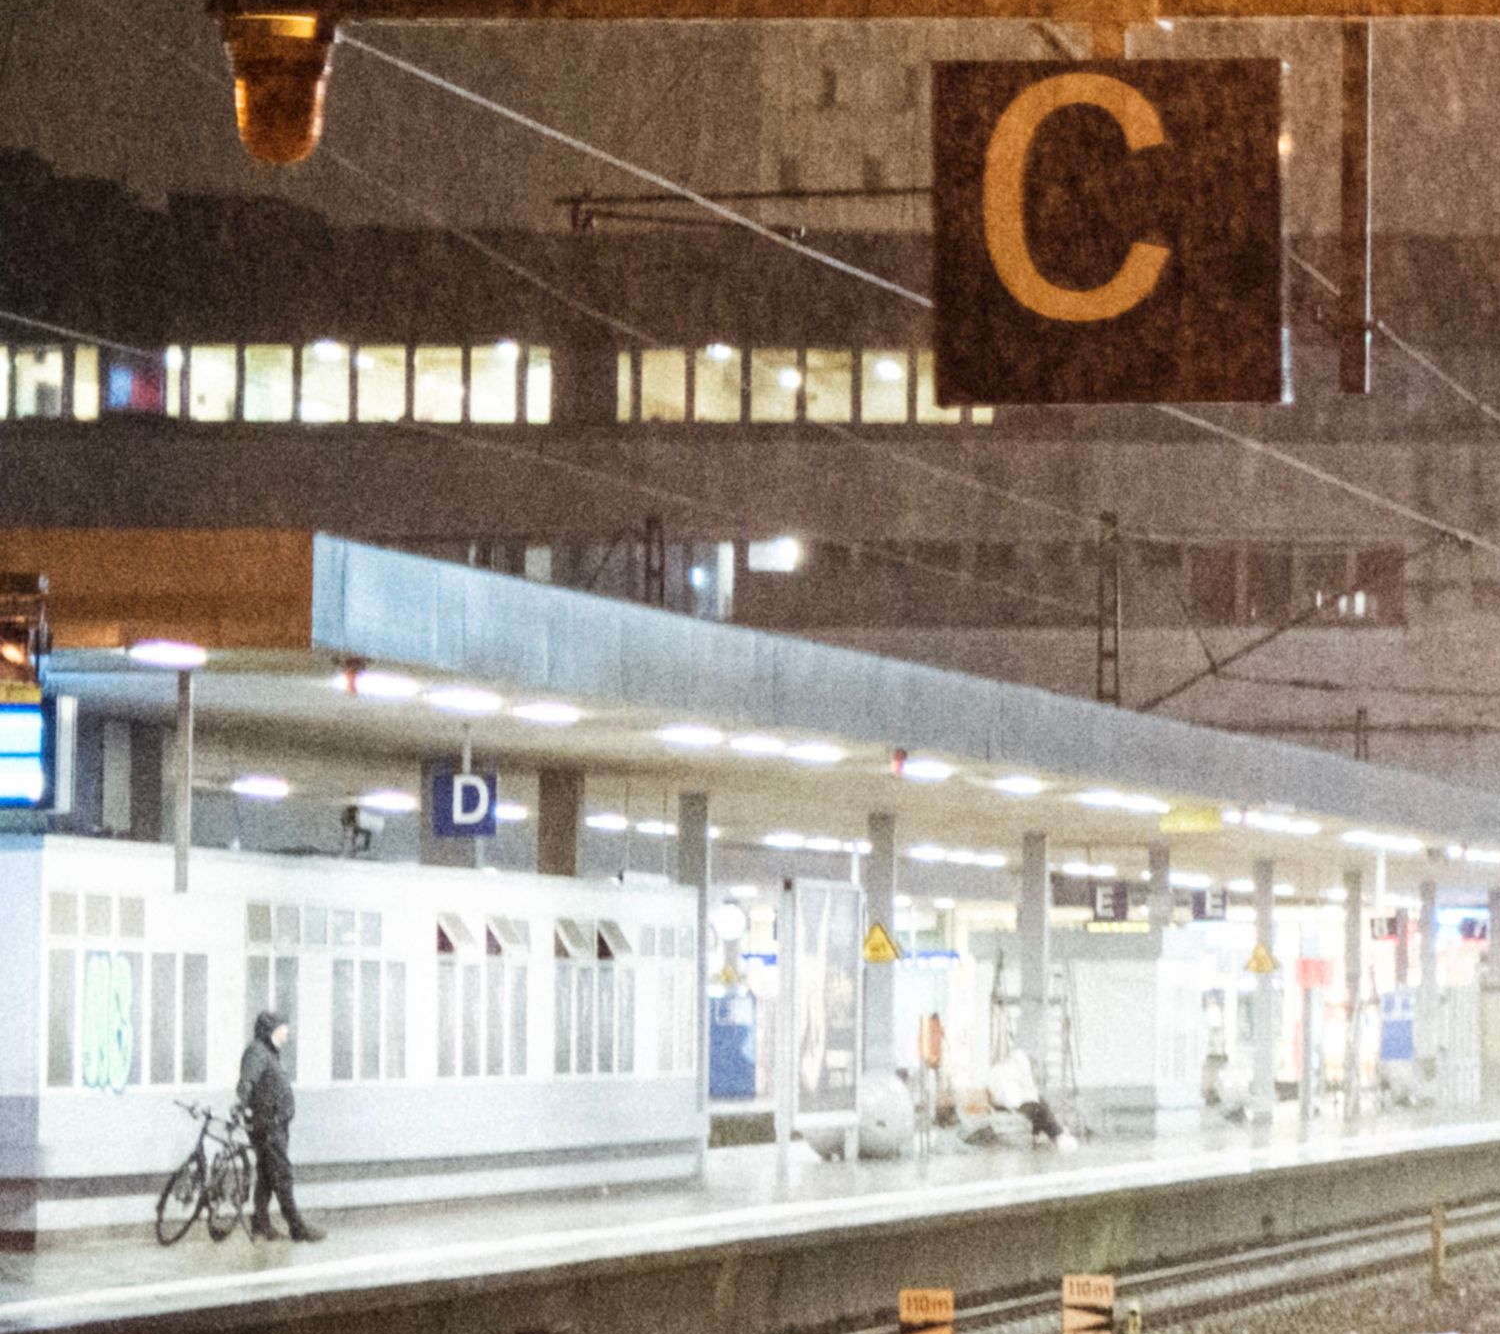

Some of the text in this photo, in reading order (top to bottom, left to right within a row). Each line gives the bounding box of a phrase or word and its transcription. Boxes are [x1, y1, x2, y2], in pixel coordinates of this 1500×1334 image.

[982, 71, 1172, 323] C
[451, 774, 489, 826] D
[1095, 885, 1116, 918] E
[1204, 887, 1224, 918] E
